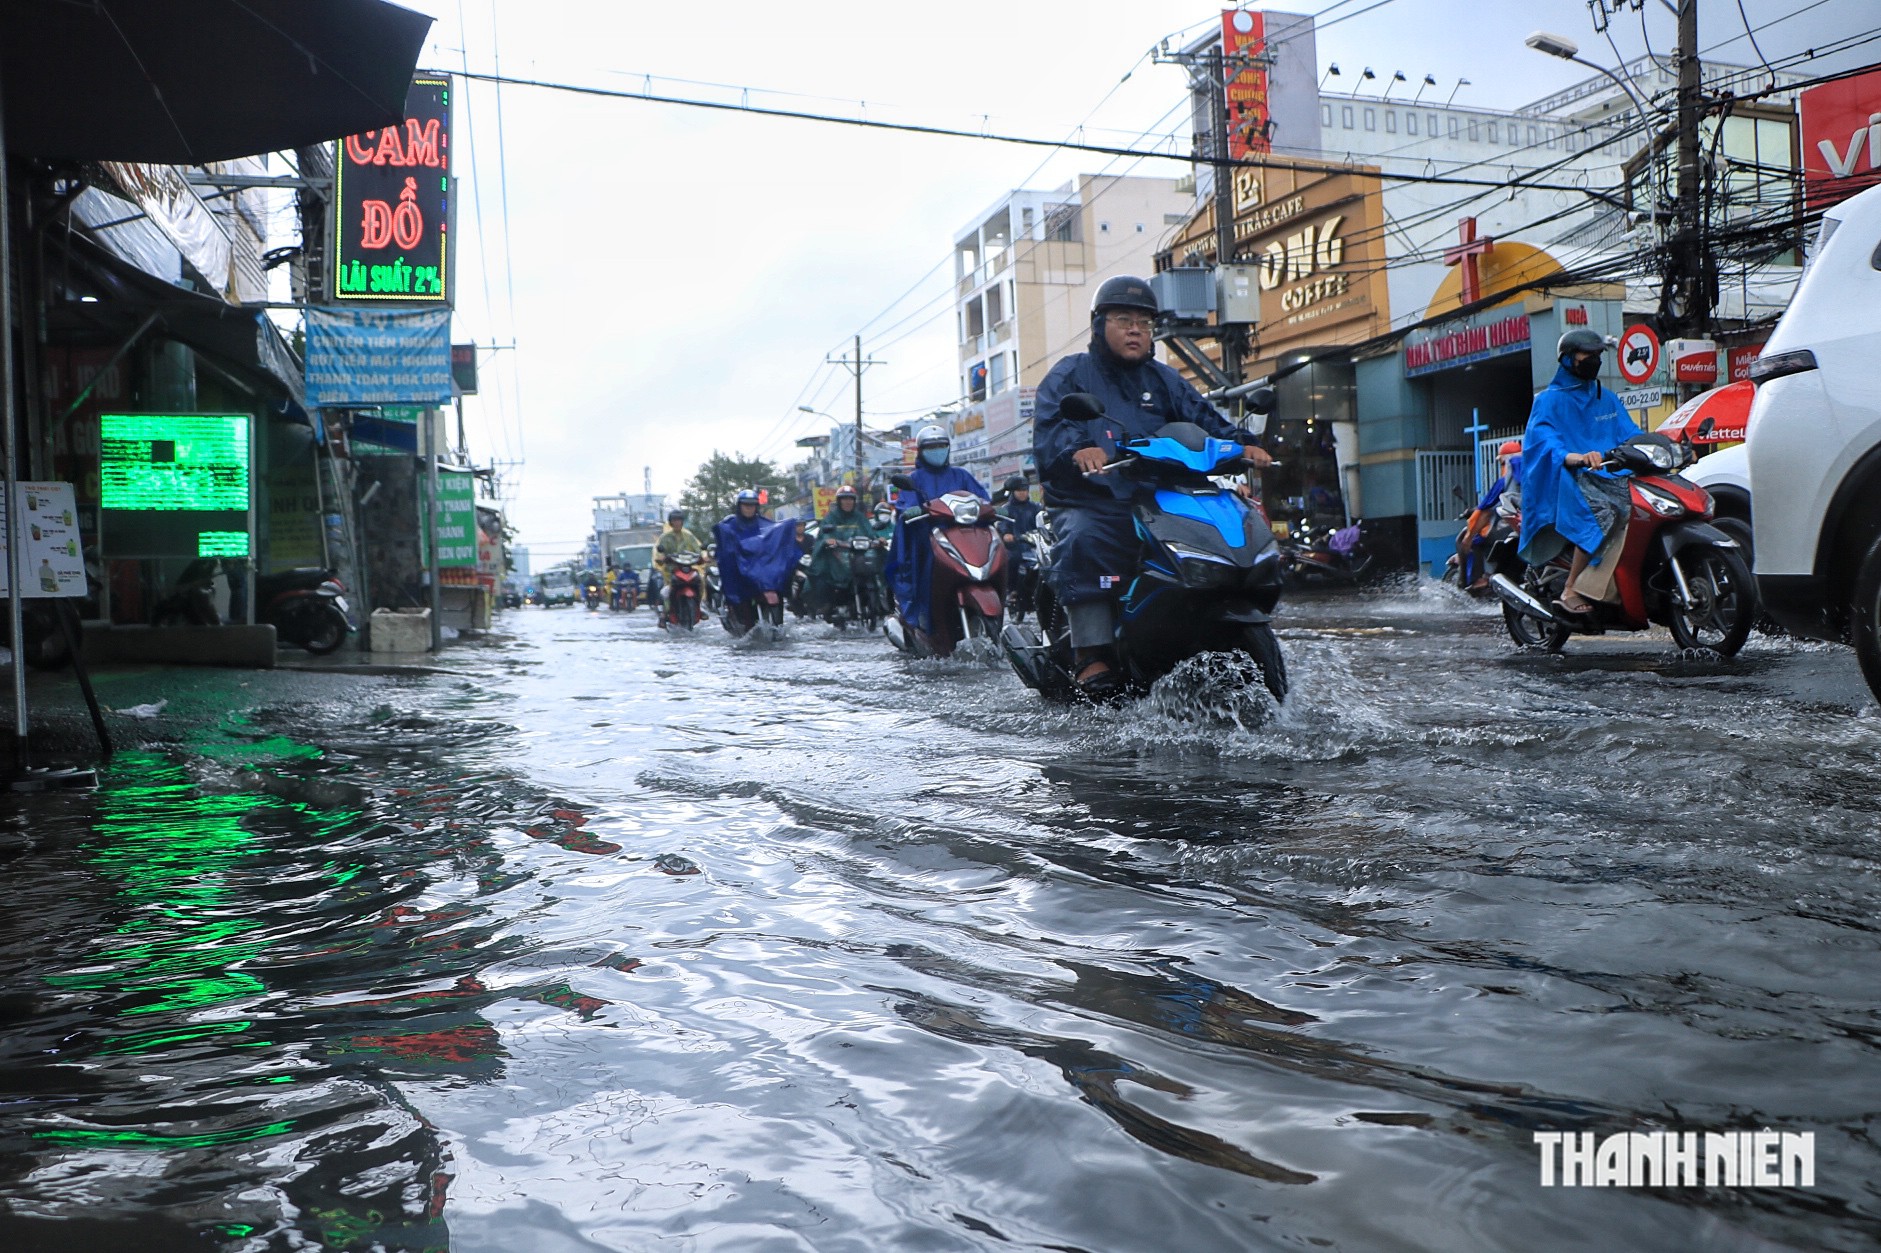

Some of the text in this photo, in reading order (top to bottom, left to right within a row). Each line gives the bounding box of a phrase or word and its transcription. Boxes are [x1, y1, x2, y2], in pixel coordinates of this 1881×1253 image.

[361, 177, 423, 250] ĐỒ
[1273, 196, 1303, 222] CAFE
[341, 256, 441, 293] LÃI SUẤT 2%
[1281, 273, 1349, 311] COFFEE
[1566, 304, 1588, 325] NHÀ
[1406, 337, 1433, 369] NHÀ
[1433, 330, 1457, 361] THỜ
[1457, 325, 1490, 356] BÌNH
